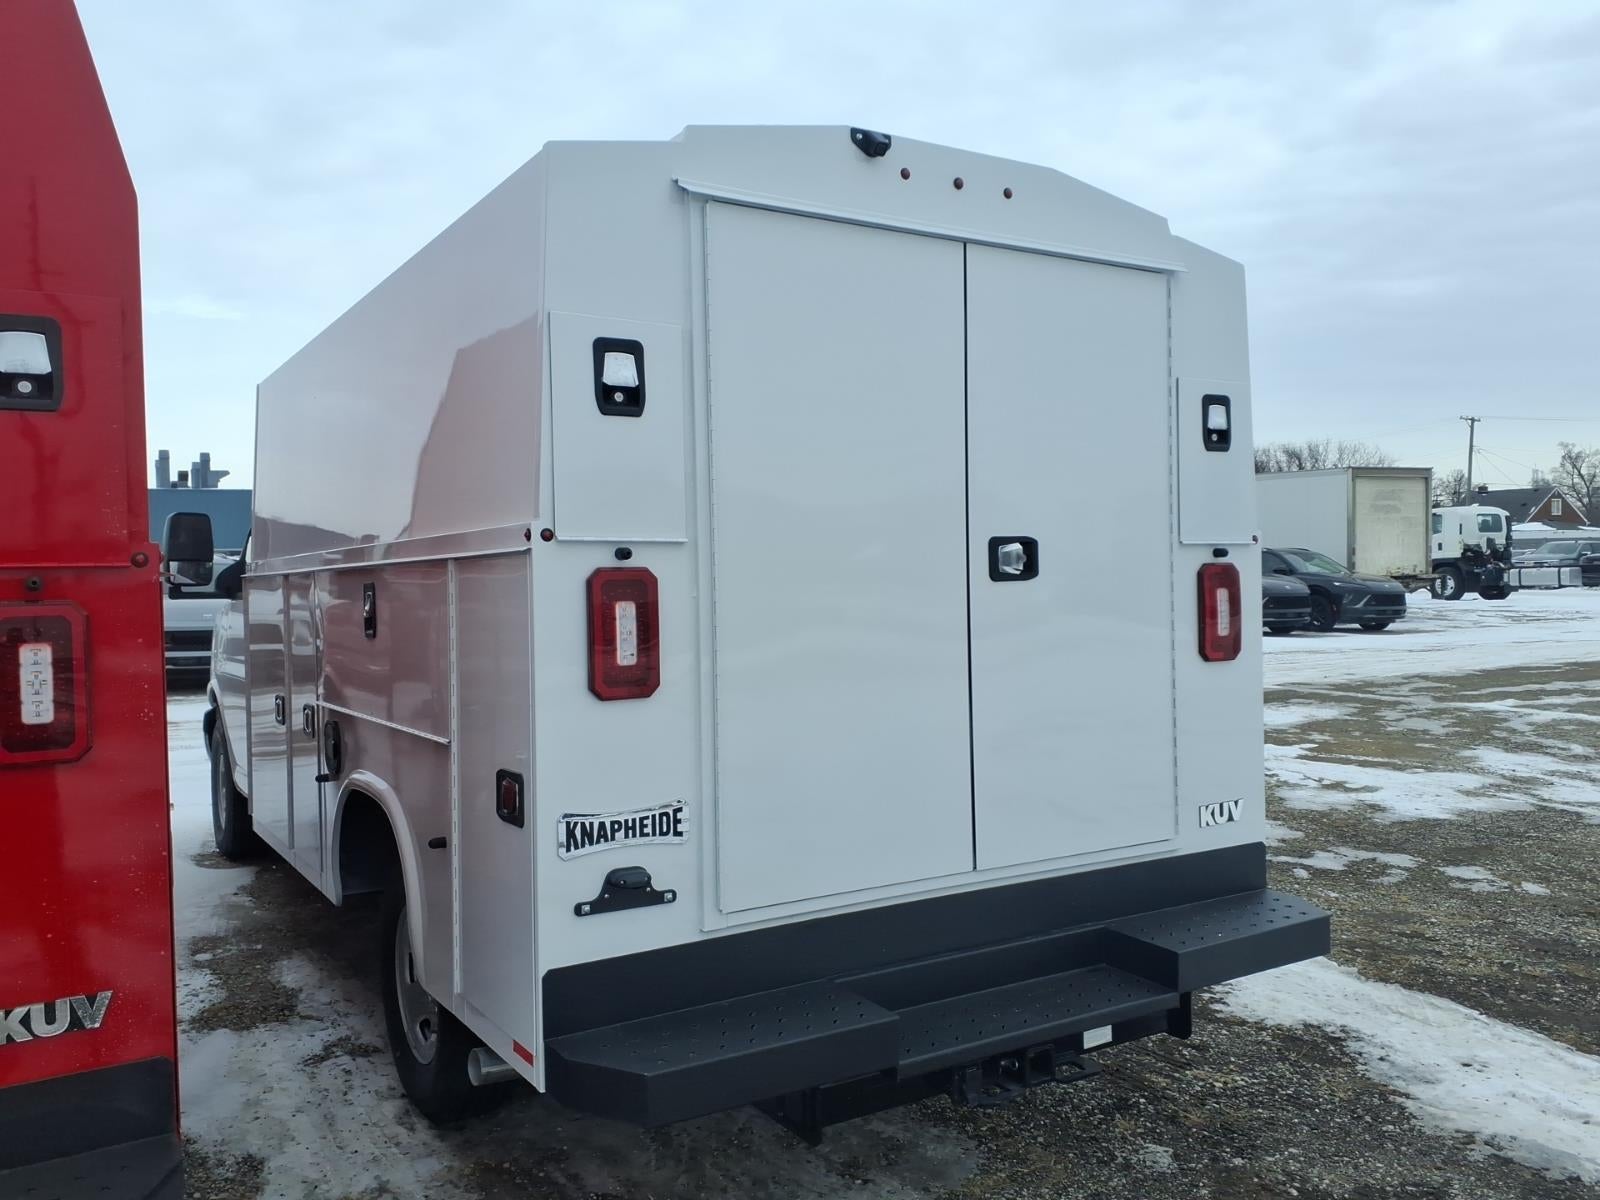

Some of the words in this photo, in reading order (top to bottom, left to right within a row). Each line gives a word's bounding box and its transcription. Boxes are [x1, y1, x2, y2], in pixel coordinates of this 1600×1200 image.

[565, 806, 683, 853] KNAPHEIDE
[1199, 798, 1244, 828] KUV
[0, 990, 113, 1046] KUV
